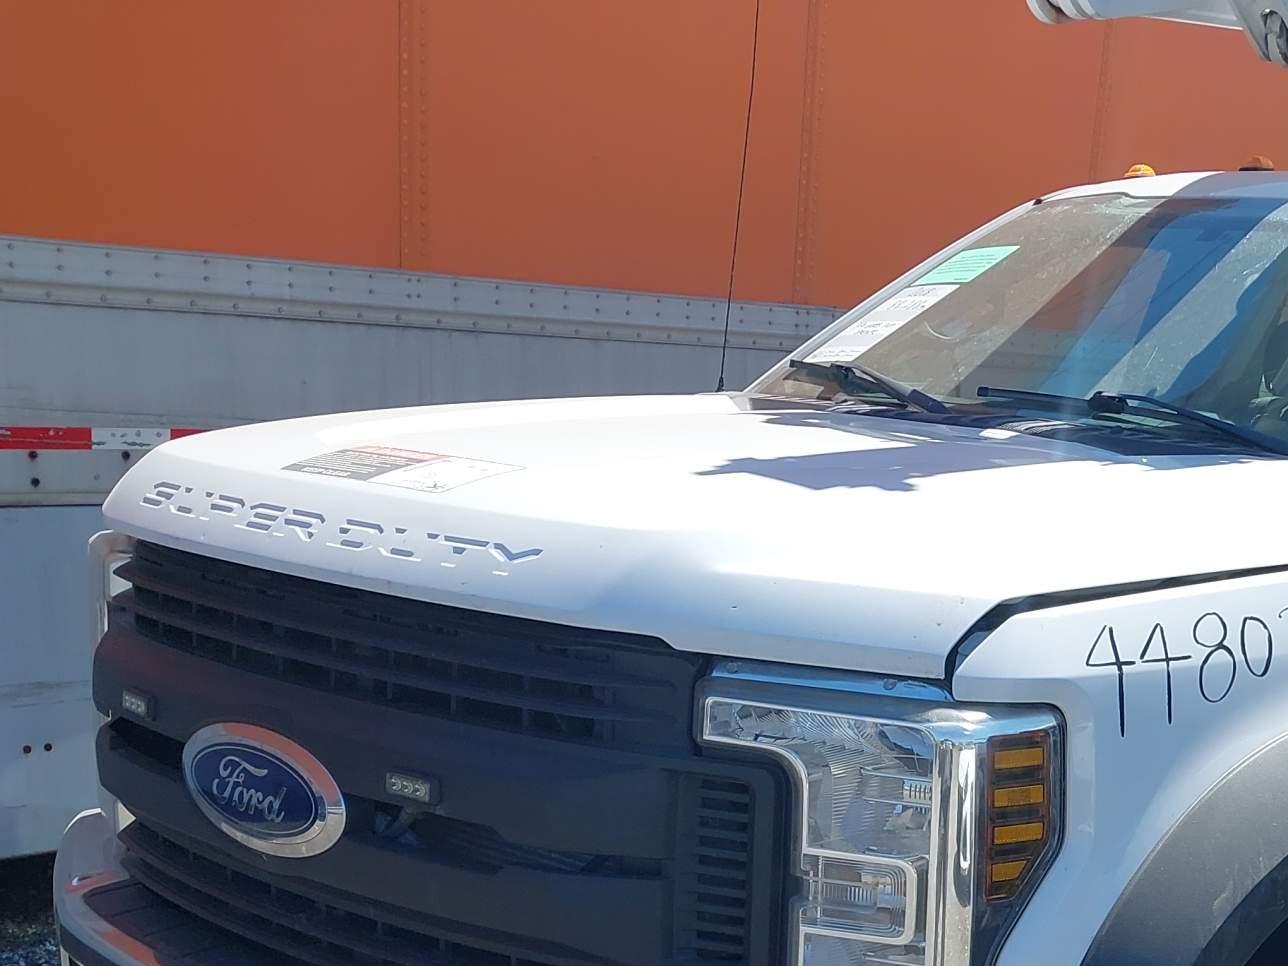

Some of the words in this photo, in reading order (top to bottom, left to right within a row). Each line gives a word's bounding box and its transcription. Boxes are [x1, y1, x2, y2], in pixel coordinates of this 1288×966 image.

[140, 481, 327, 542] SUPER
[326, 518, 544, 576] DUTY
[212, 755, 287, 823] Ford
